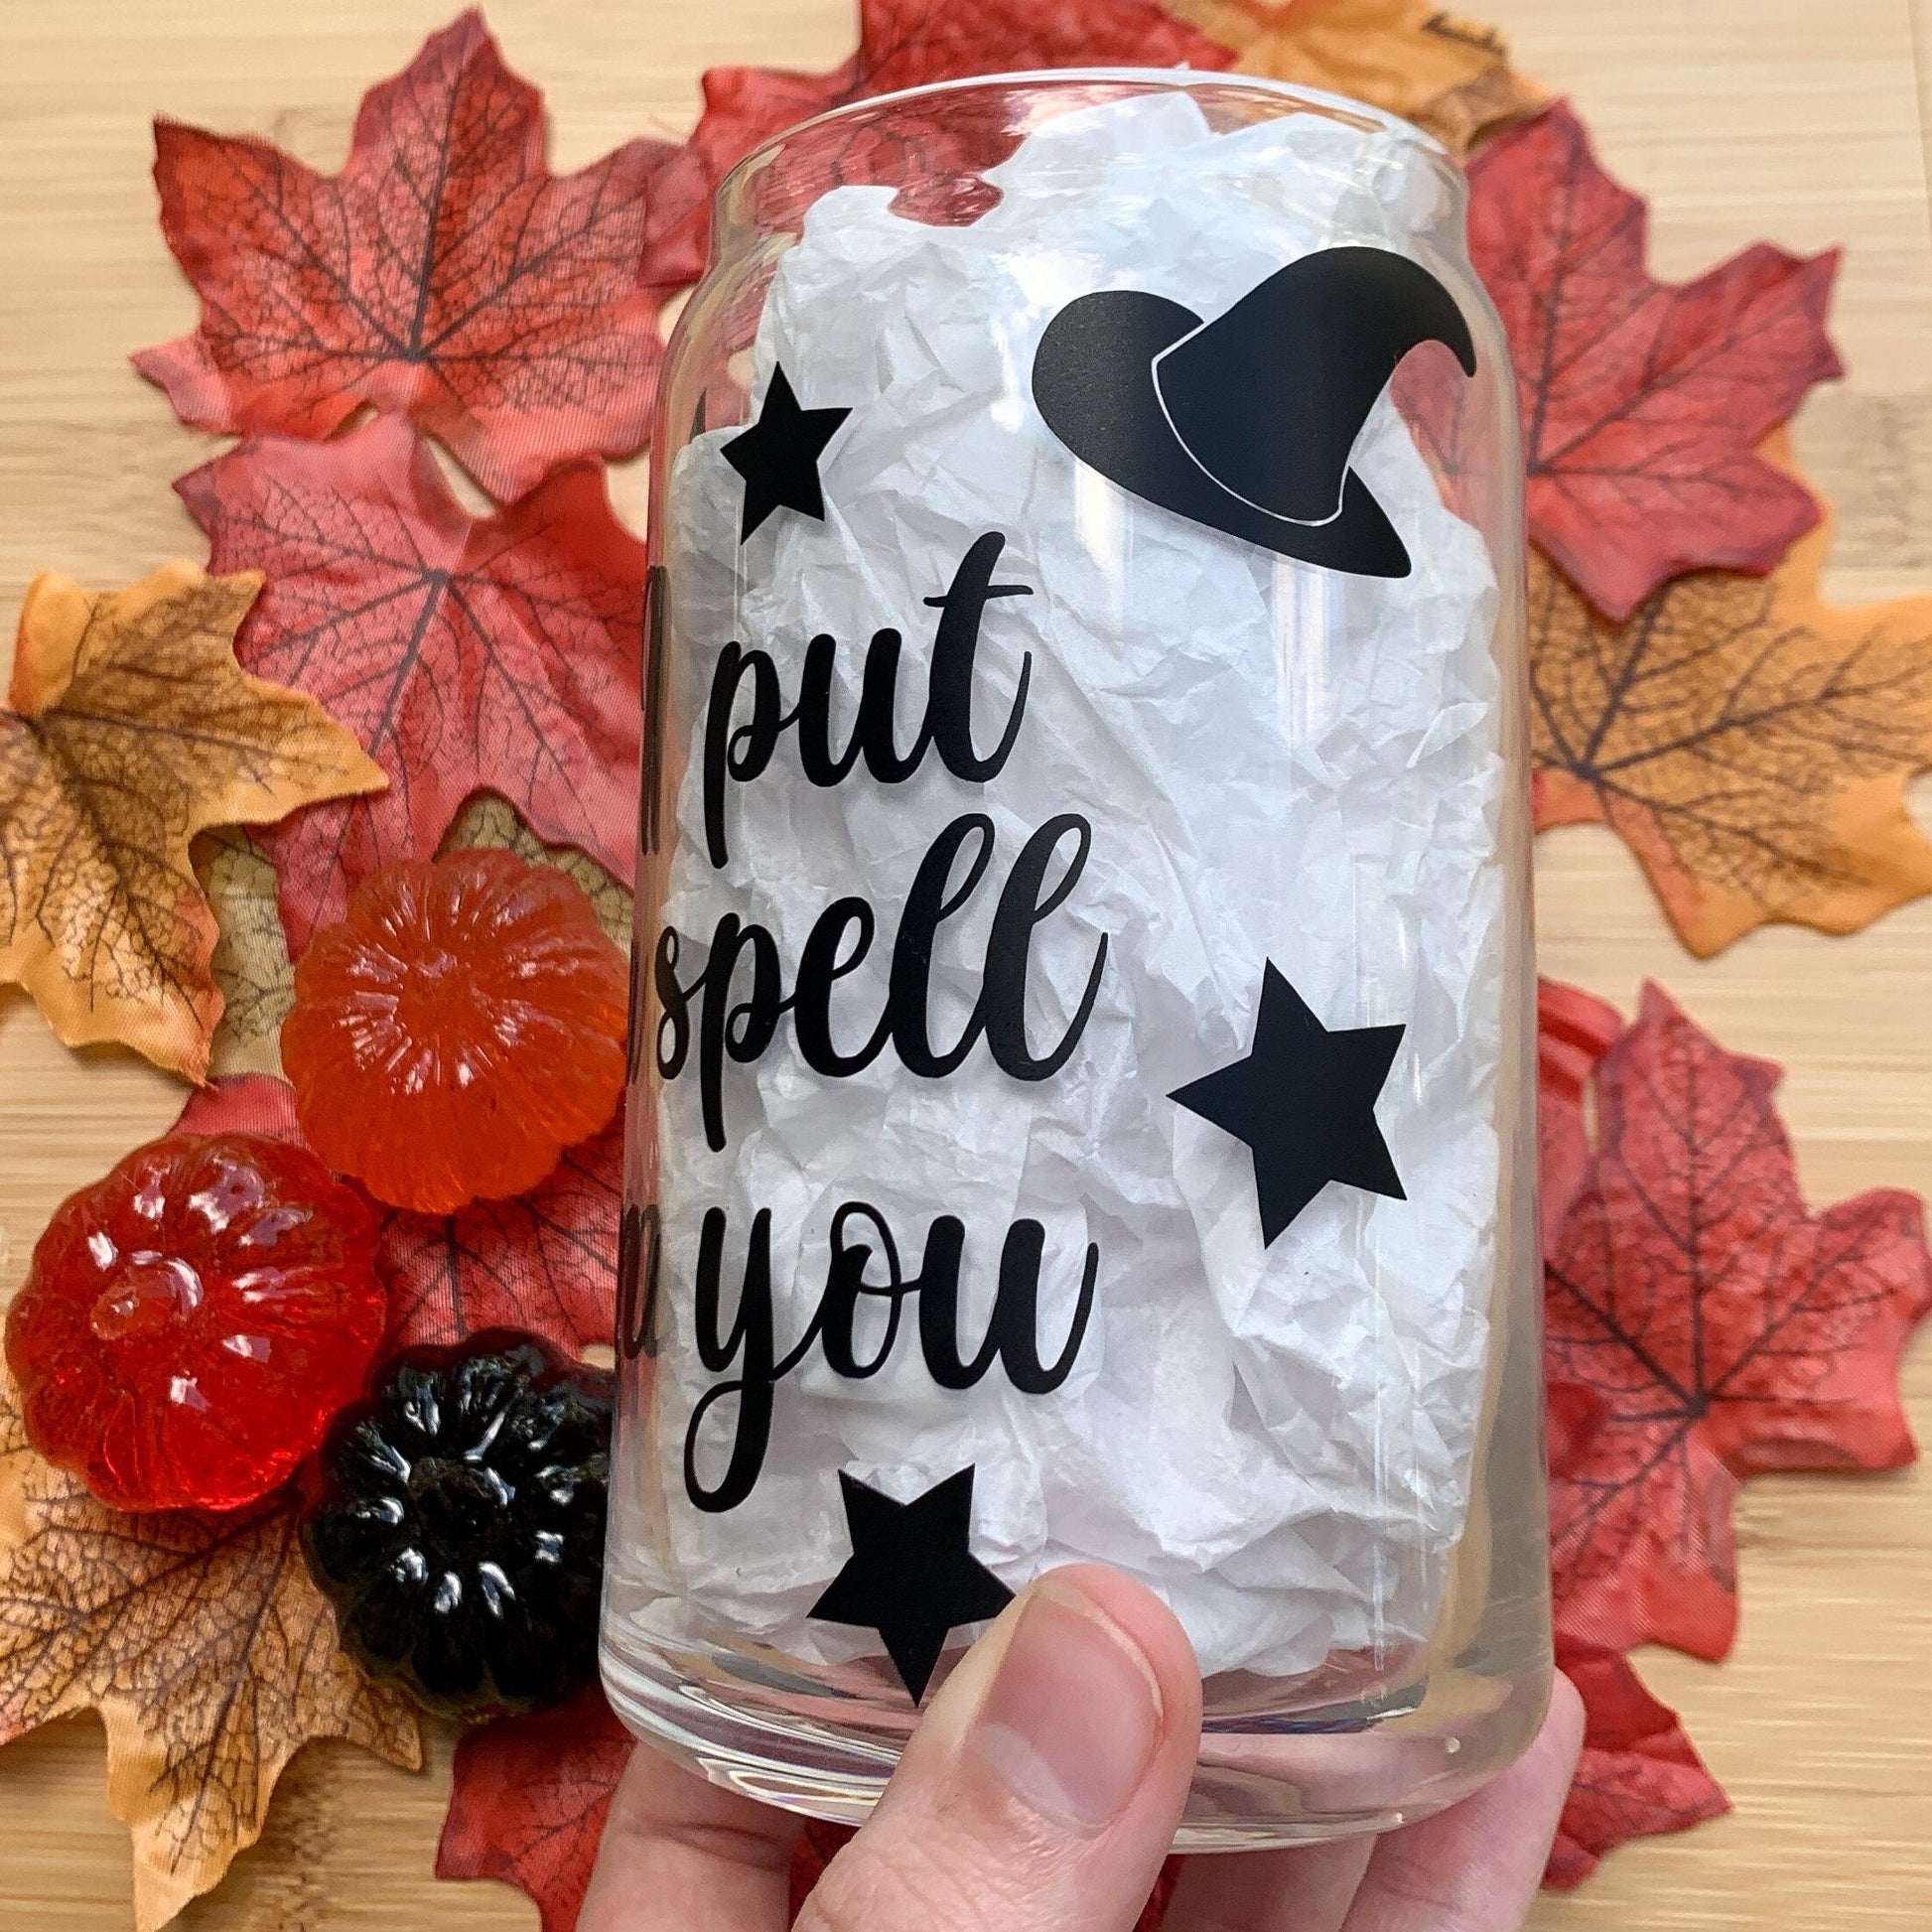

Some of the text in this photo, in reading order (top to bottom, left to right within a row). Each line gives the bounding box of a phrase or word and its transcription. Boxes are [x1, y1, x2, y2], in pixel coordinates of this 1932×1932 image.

[703, 531, 1034, 870] put
[653, 813, 1109, 1153] spell
[683, 1201, 1099, 1513] you
